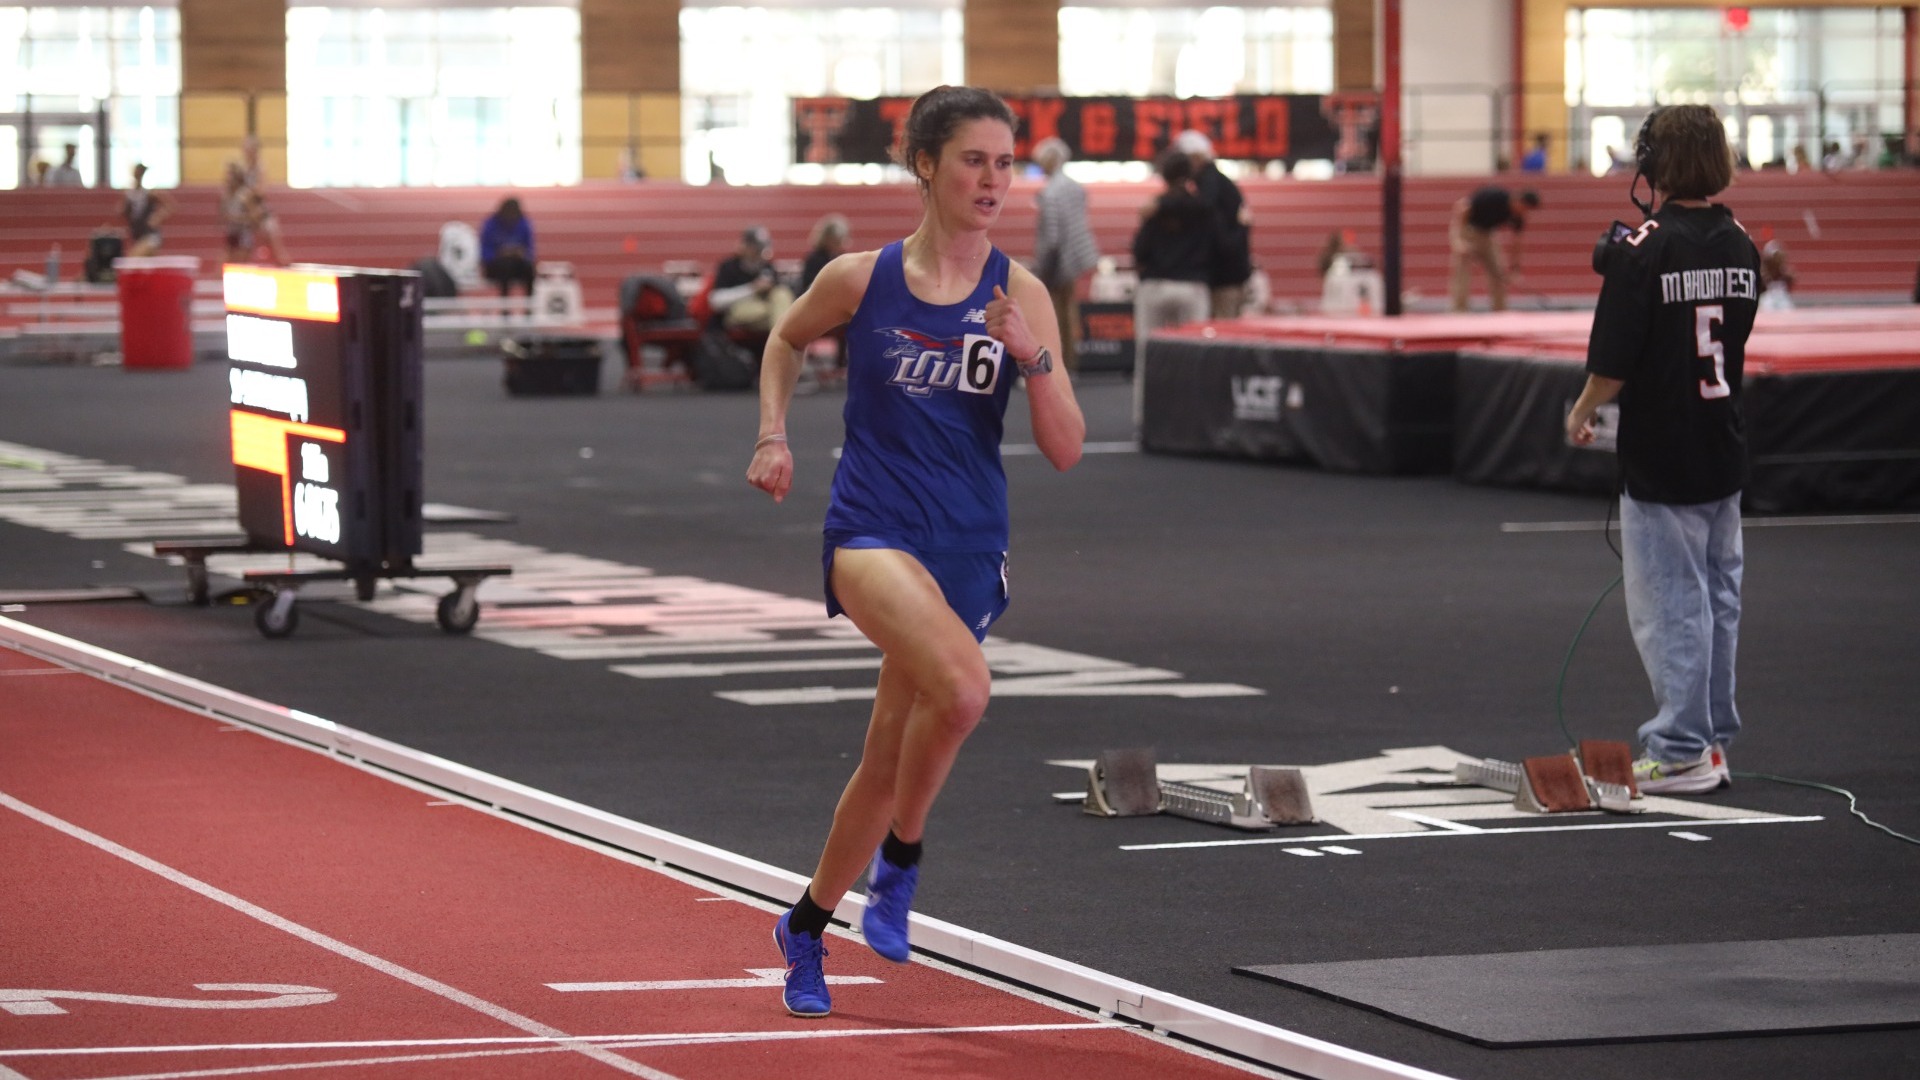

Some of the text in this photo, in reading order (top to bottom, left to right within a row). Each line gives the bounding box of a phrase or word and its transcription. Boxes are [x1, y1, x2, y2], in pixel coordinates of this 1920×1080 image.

[891, 350, 962, 395] LCU
[966, 339, 997, 390] 6
[1694, 304, 1731, 400] 5
